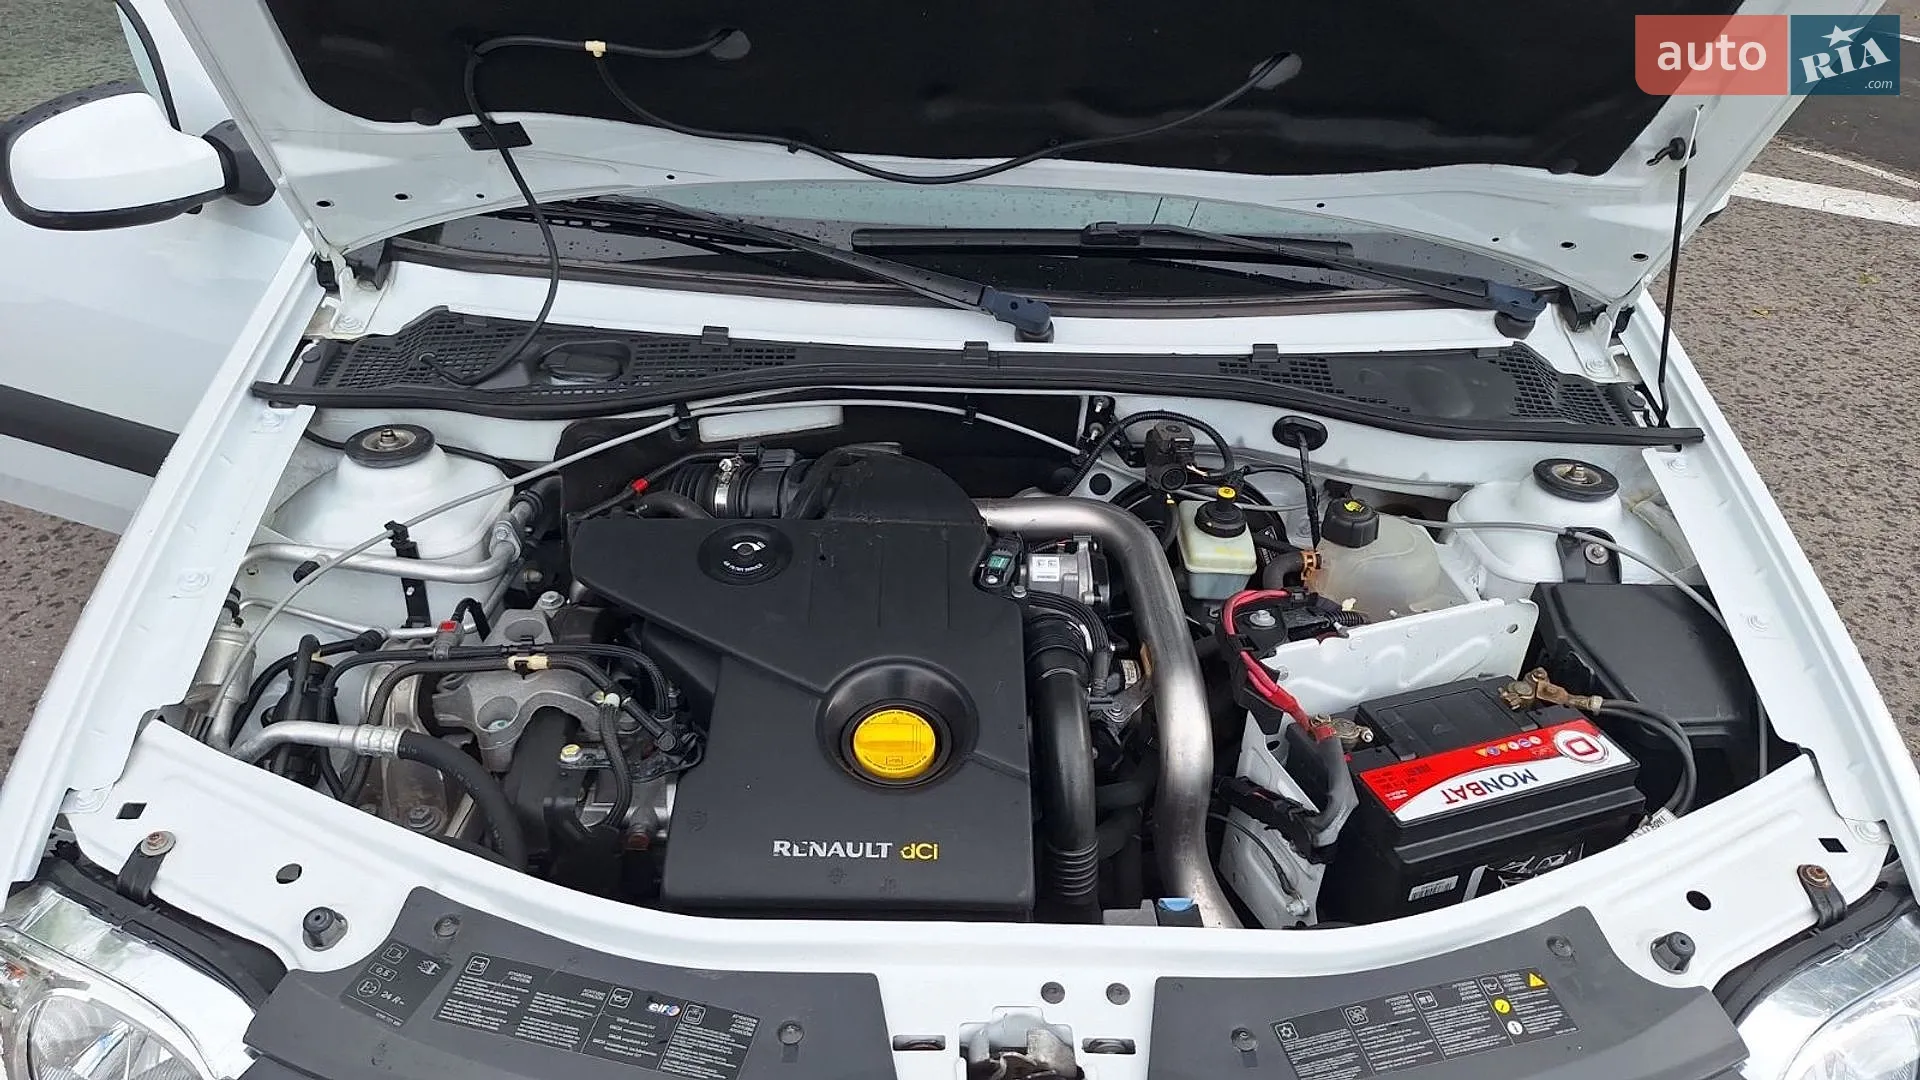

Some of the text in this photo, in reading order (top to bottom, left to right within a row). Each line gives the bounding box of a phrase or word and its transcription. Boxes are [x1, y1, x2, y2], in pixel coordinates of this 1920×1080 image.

[1441, 769, 1539, 804] MONBAT
[773, 840, 939, 860] RENAULT dCi
